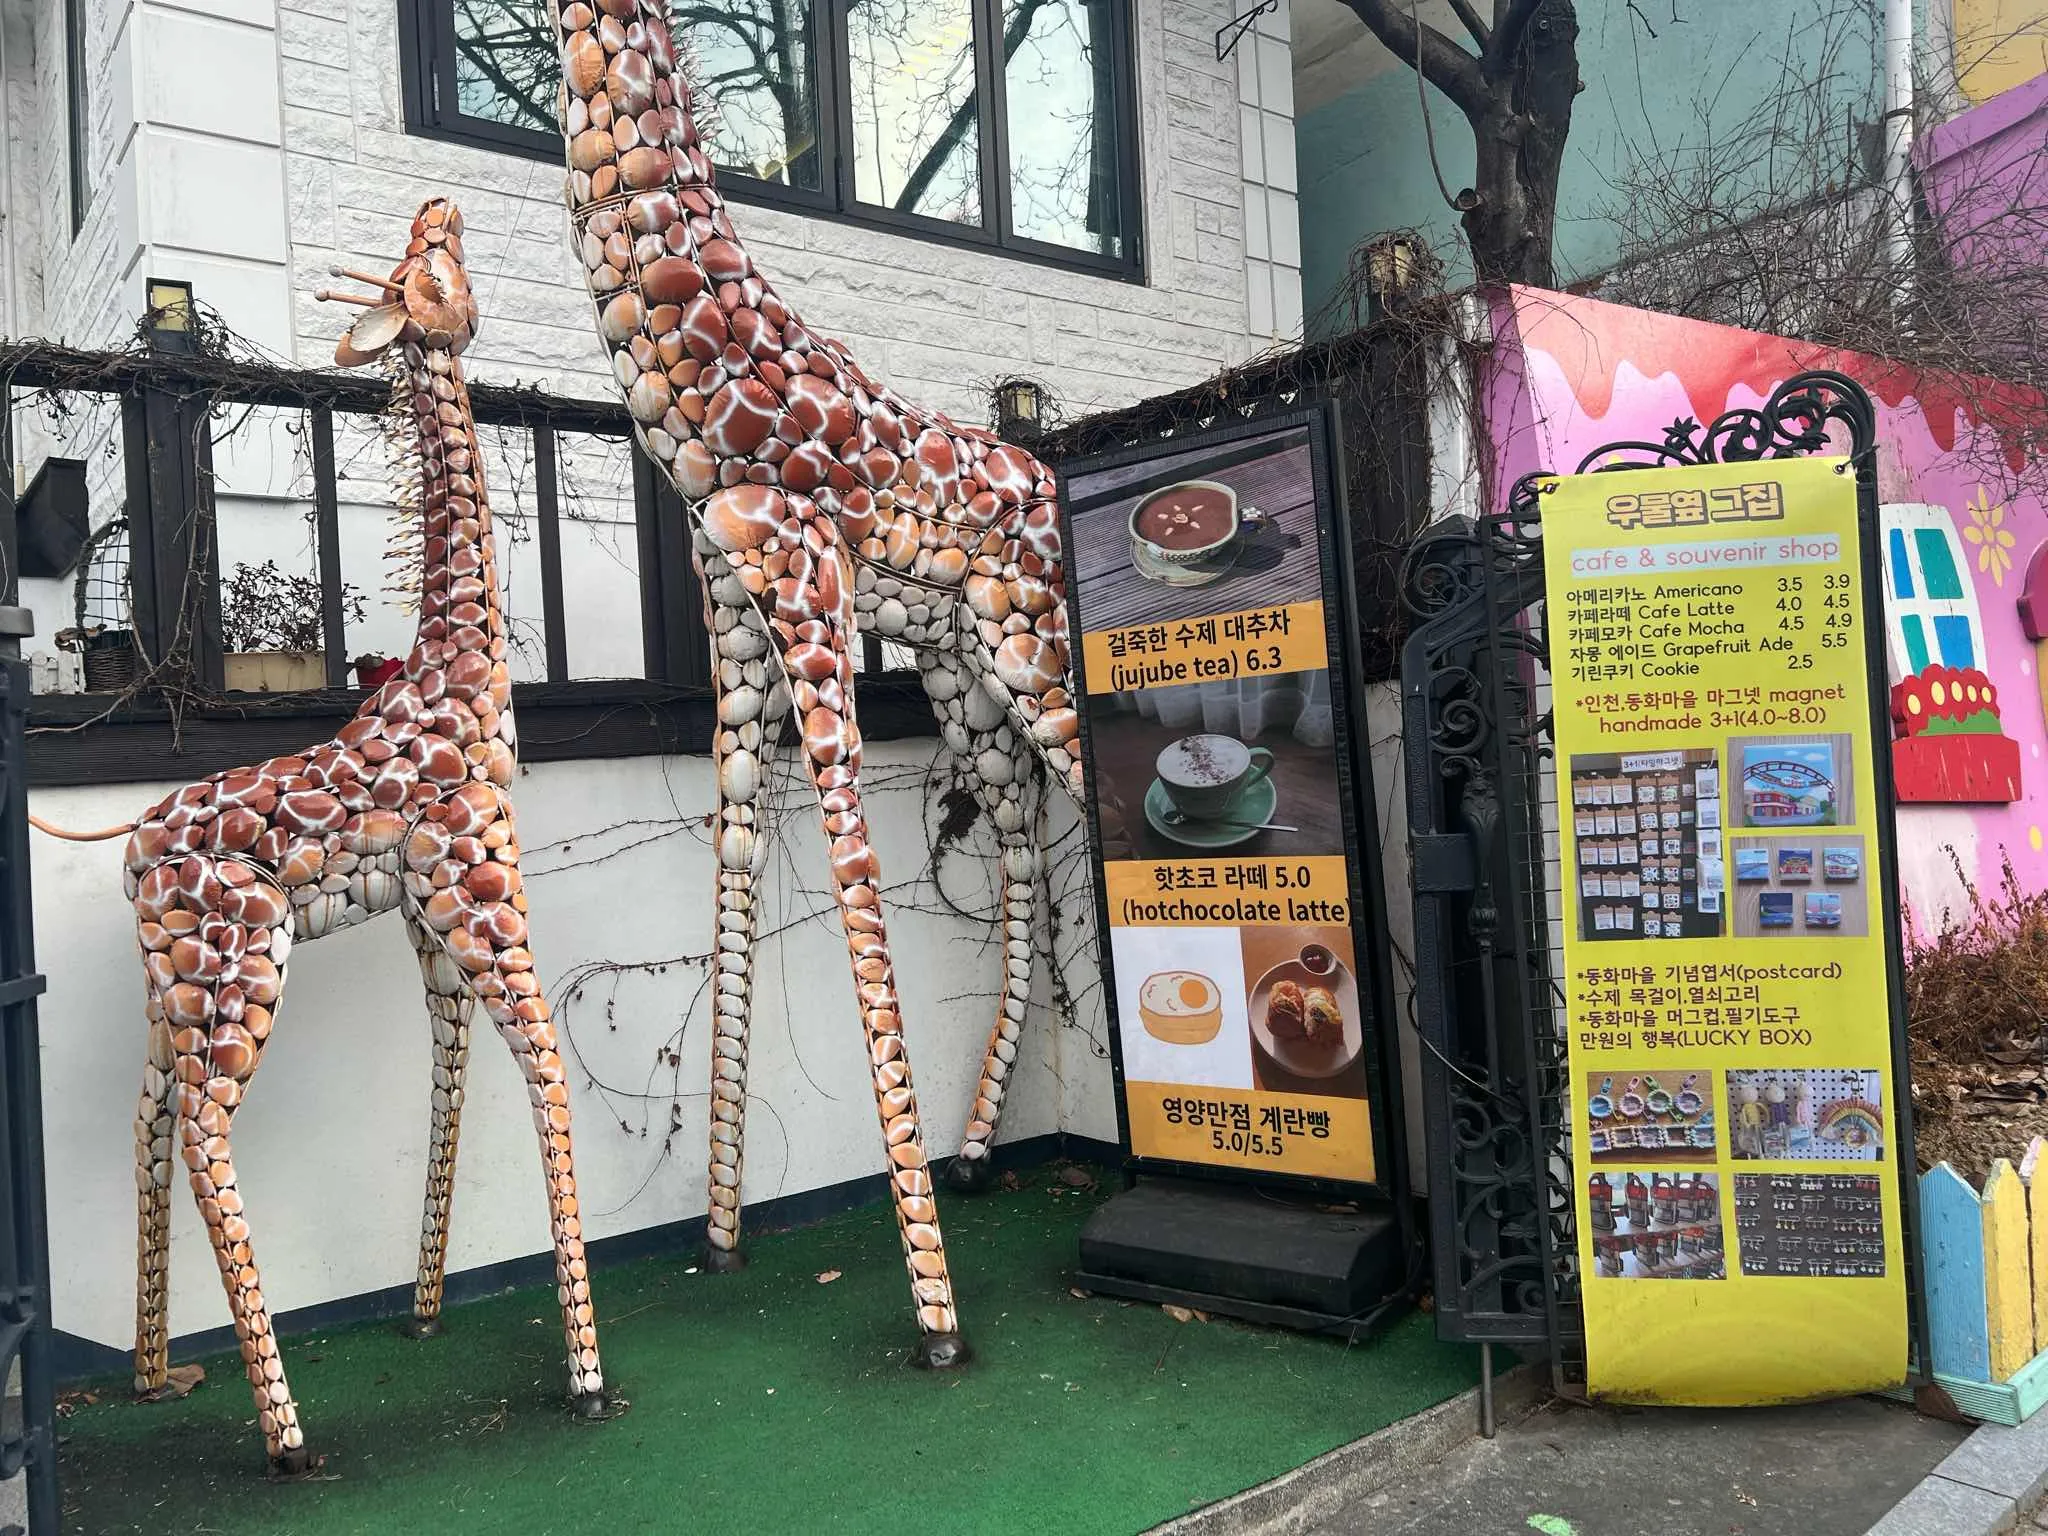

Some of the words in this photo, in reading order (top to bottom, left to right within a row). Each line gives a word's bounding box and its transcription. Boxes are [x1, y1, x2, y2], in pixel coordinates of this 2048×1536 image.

[1606, 490, 1709, 530] 우물옆
[1710, 481, 1784, 522] 그집
[1572, 550, 1628, 571] cafe
[1639, 549, 1656, 568] &
[1666, 542, 1768, 567] souvenir
[1778, 535, 1839, 562] shop
[1566, 587, 1647, 606] 아메리카노
[1654, 583, 1743, 599] Americano
[1777, 577, 1802, 592] 3.5
[1824, 574, 1851, 589] 3.9
[1568, 606, 1631, 624] 카페라떼
[1638, 604, 1681, 619] Cafe
[1687, 602, 1735, 617] Latte
[1776, 597, 1802, 612] 4.0
[1823, 593, 1850, 608] 4.5
[1107, 627, 1168, 658] 걸죽한
[1175, 618, 1217, 649] 수제
[1224, 608, 1291, 642] 대추차
[1569, 625, 1633, 643] 카페모카
[1639, 623, 1682, 638] Cafe
[1688, 620, 1745, 636] Mocha
[1778, 616, 1805, 631] 4.5
[1825, 613, 1852, 628] 4.9
[1570, 646, 1601, 663] 자몽
[1608, 643, 1657, 661] 에이드
[1663, 640, 1750, 658] Grapefruit
[1758, 637, 1793, 652] Ade
[1822, 633, 1848, 648] 5.5
[1110, 660, 1187, 692] (jujube
[1193, 651, 1239, 679] tea)
[1246, 645, 1282, 671] 6.3
[1571, 663, 1634, 683] 기린쿠키
[1641, 661, 1700, 677] Cookie
[1787, 654, 1813, 670] 2.5
[1707, 687, 1761, 705] 마그넷
[1769, 684, 1846, 705] magnet
[1600, 713, 1701, 733] handmade
[1709, 706, 1826, 728] 3+1(4.0~8.0)
[1153, 865, 1217, 892] 핫초코
[1224, 864, 1268, 891] 라떼
[1275, 866, 1311, 888] 5.0
[1123, 898, 1281, 925] (hotchocolate
[1665, 962, 1843, 983] 기념엽서(postcard)
[1580, 1031, 1632, 1050] 만원의
[1641, 1029, 1750, 1048] 행복(LUCKY
[1759, 1028, 1812, 1046] BOX)
[1162, 1097, 1250, 1130] 영양만점
[1259, 1106, 1331, 1139] 계란빵
[1212, 1130, 1283, 1156] 5.0/5.5
